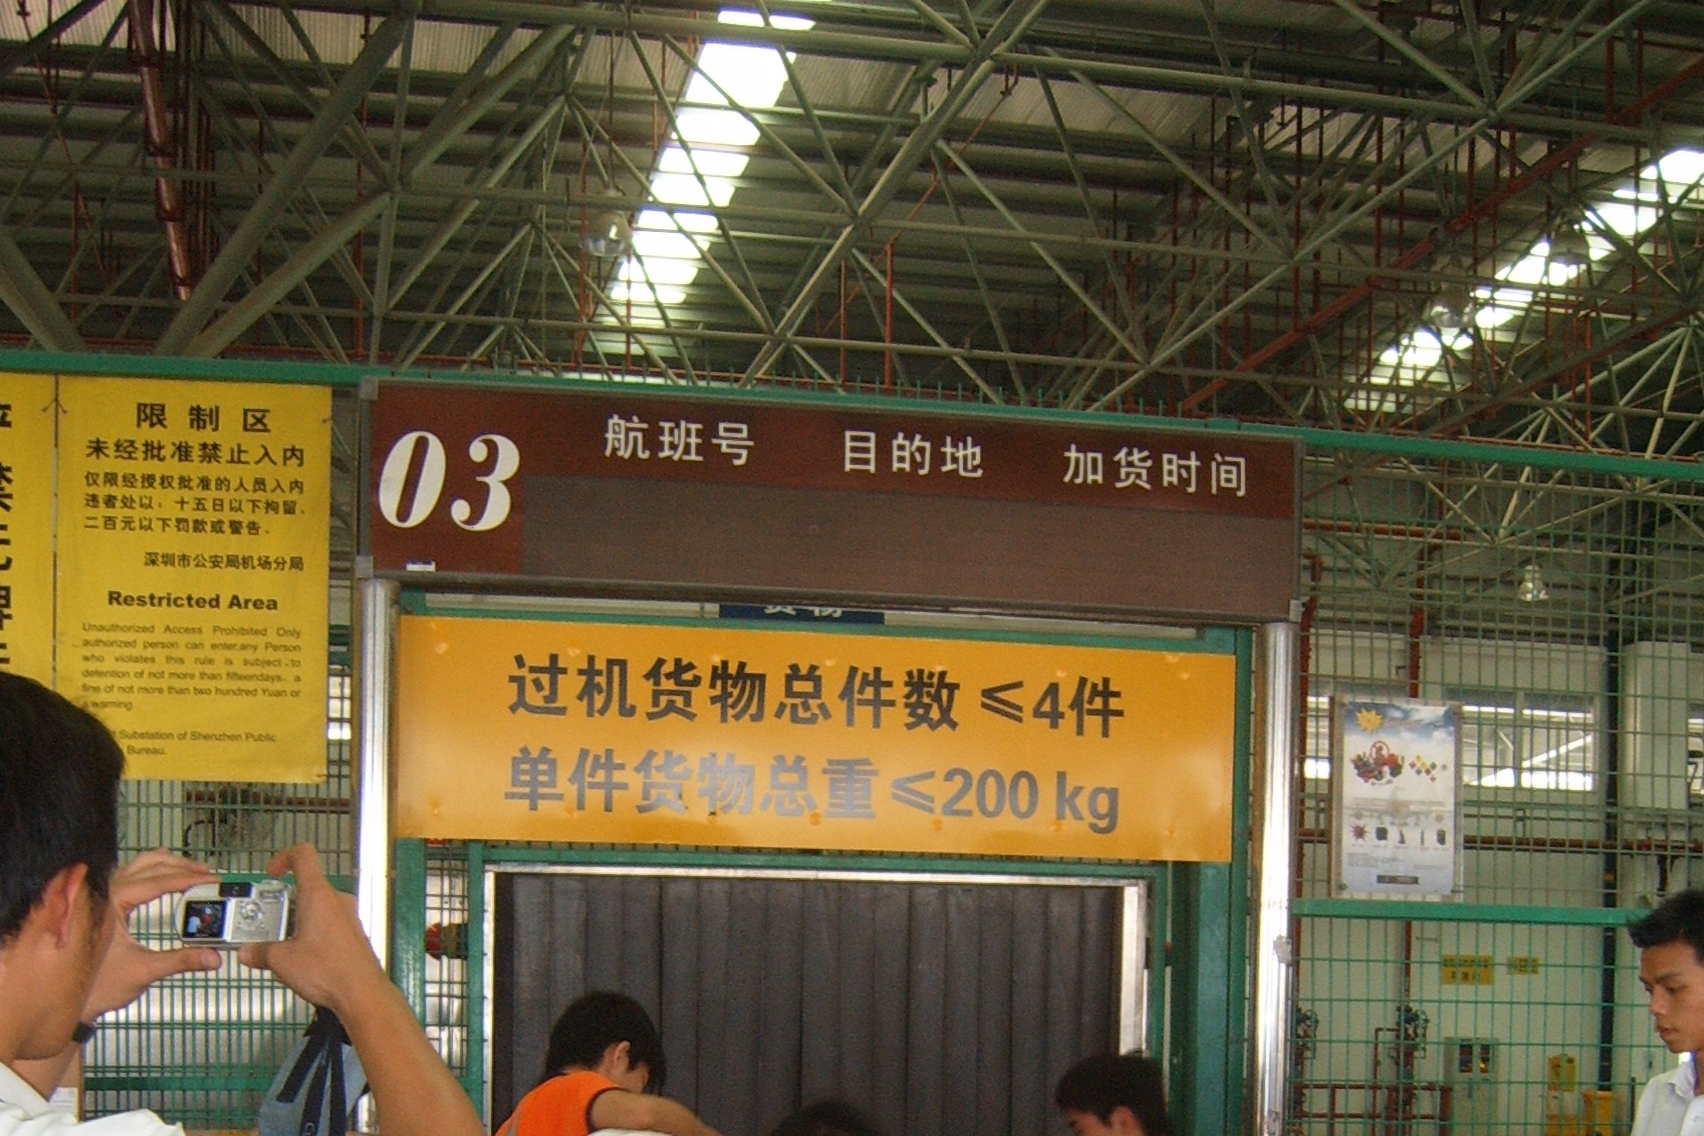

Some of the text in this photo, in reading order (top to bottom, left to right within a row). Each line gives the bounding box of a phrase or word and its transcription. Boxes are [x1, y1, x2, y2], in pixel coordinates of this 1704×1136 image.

[136, 402, 271, 433] 限制区
[85, 437, 305, 468] 未经批准禁止入内
[604, 413, 1248, 497] 航班号 目的地 加货时间
[84, 471, 305, 495] 仅限经授权批准的人员入内
[378, 430, 521, 532] 03
[143, 551, 305, 572] 深圳市公安局机场分局
[108, 590, 279, 611] Restricted Area
[82, 622, 302, 640] Unauthorized Access Prohibited Only
[82, 638, 138, 649] authorized
[143, 640, 179, 651] person
[185, 640, 204, 650] can
[265, 641, 301, 653] Person
[82, 653, 105, 663] who
[114, 654, 156, 665] violates
[165, 654, 185, 665] this
[194, 656, 215, 666] rule
[224, 656, 234, 666] is
[243, 657, 282, 669] subject
[82, 668, 131, 679] detention
[134, 668, 145, 679] of
[148, 669, 165, 680] not
[169, 671, 195, 681] more
[199, 671, 222, 681] than
[82, 683, 301, 698] fine of not more than two hundred Yuan or
[508, 653, 960, 732] 过机货物总件数
[118, 729, 175, 740] Substation
[177, 730, 188, 741] of
[190, 730, 243, 742] Shenzhen
[245, 732, 277, 743] Public
